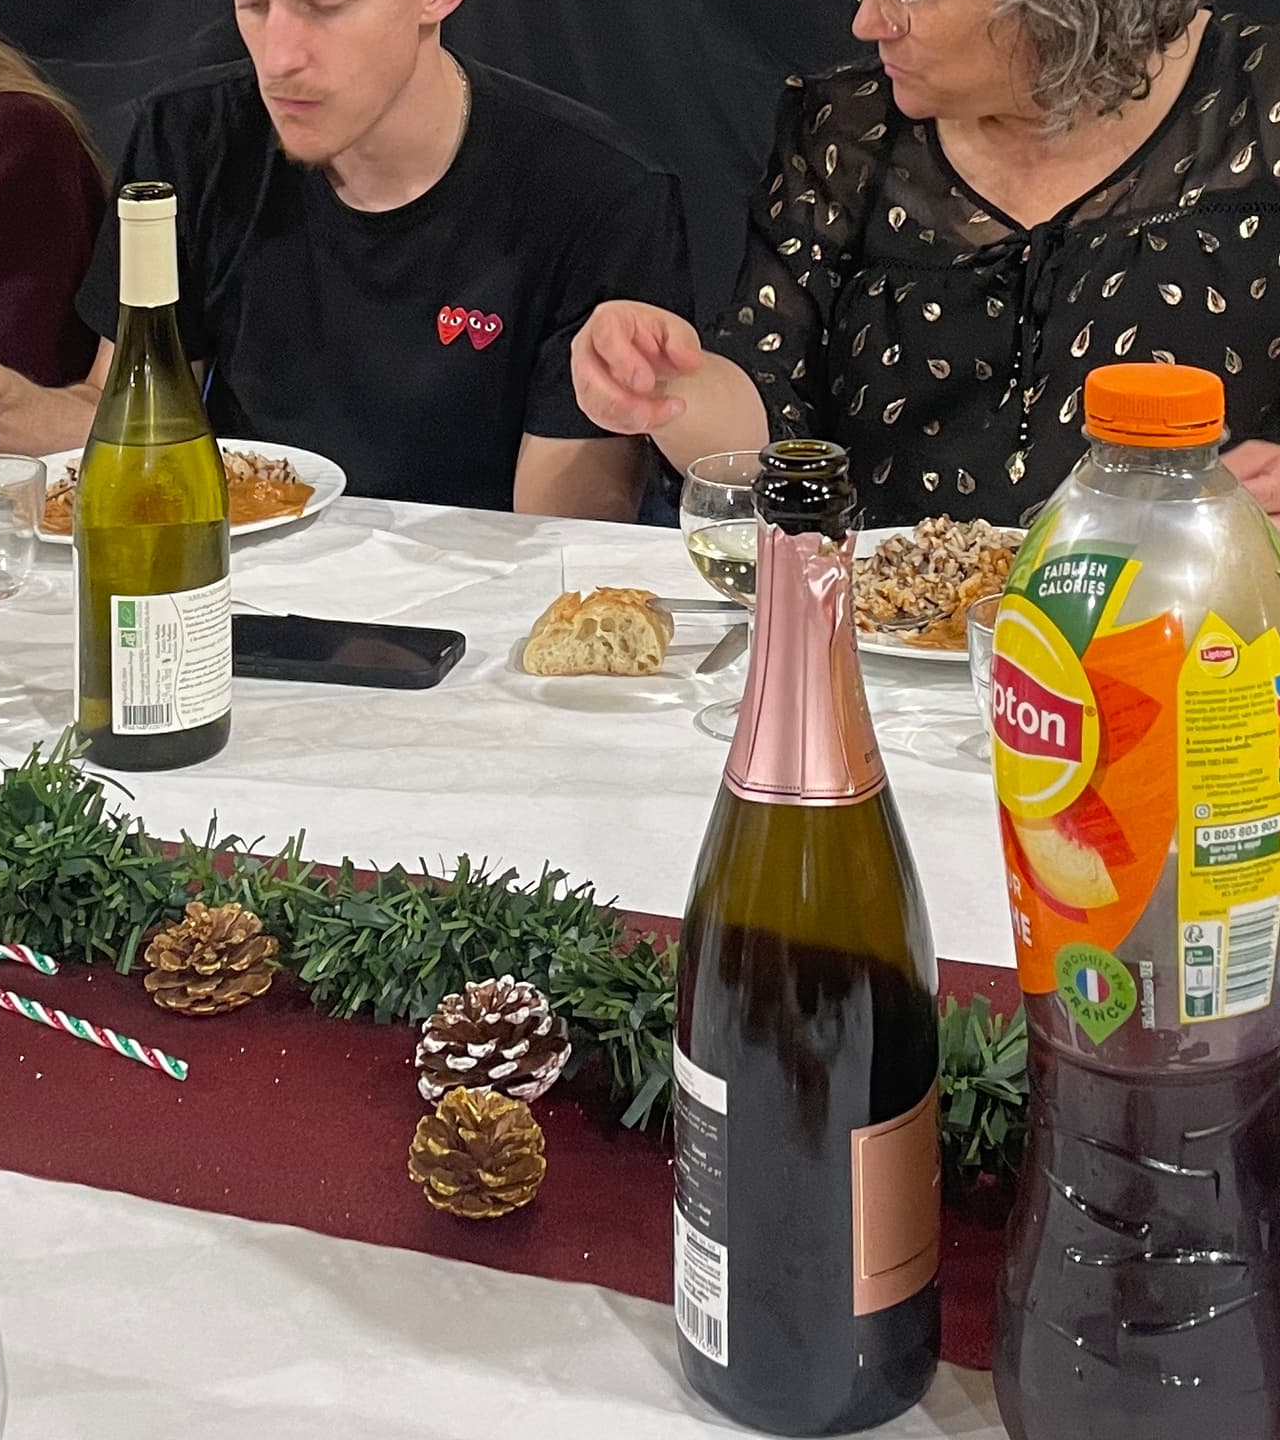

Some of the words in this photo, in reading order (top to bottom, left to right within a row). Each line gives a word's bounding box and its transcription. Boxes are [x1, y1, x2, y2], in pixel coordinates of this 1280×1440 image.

[1043, 561, 1087, 580] FAIBLE
[1088, 561, 1108, 578] EN
[1038, 579, 1106, 597] CALORIES
[992, 679, 1066, 747] pton
[1202, 830, 1210, 842] 0
[1213, 827, 1237, 841] 805
[1238, 824, 1259, 839] 803
[1063, 985, 1128, 1022] FRANCE
